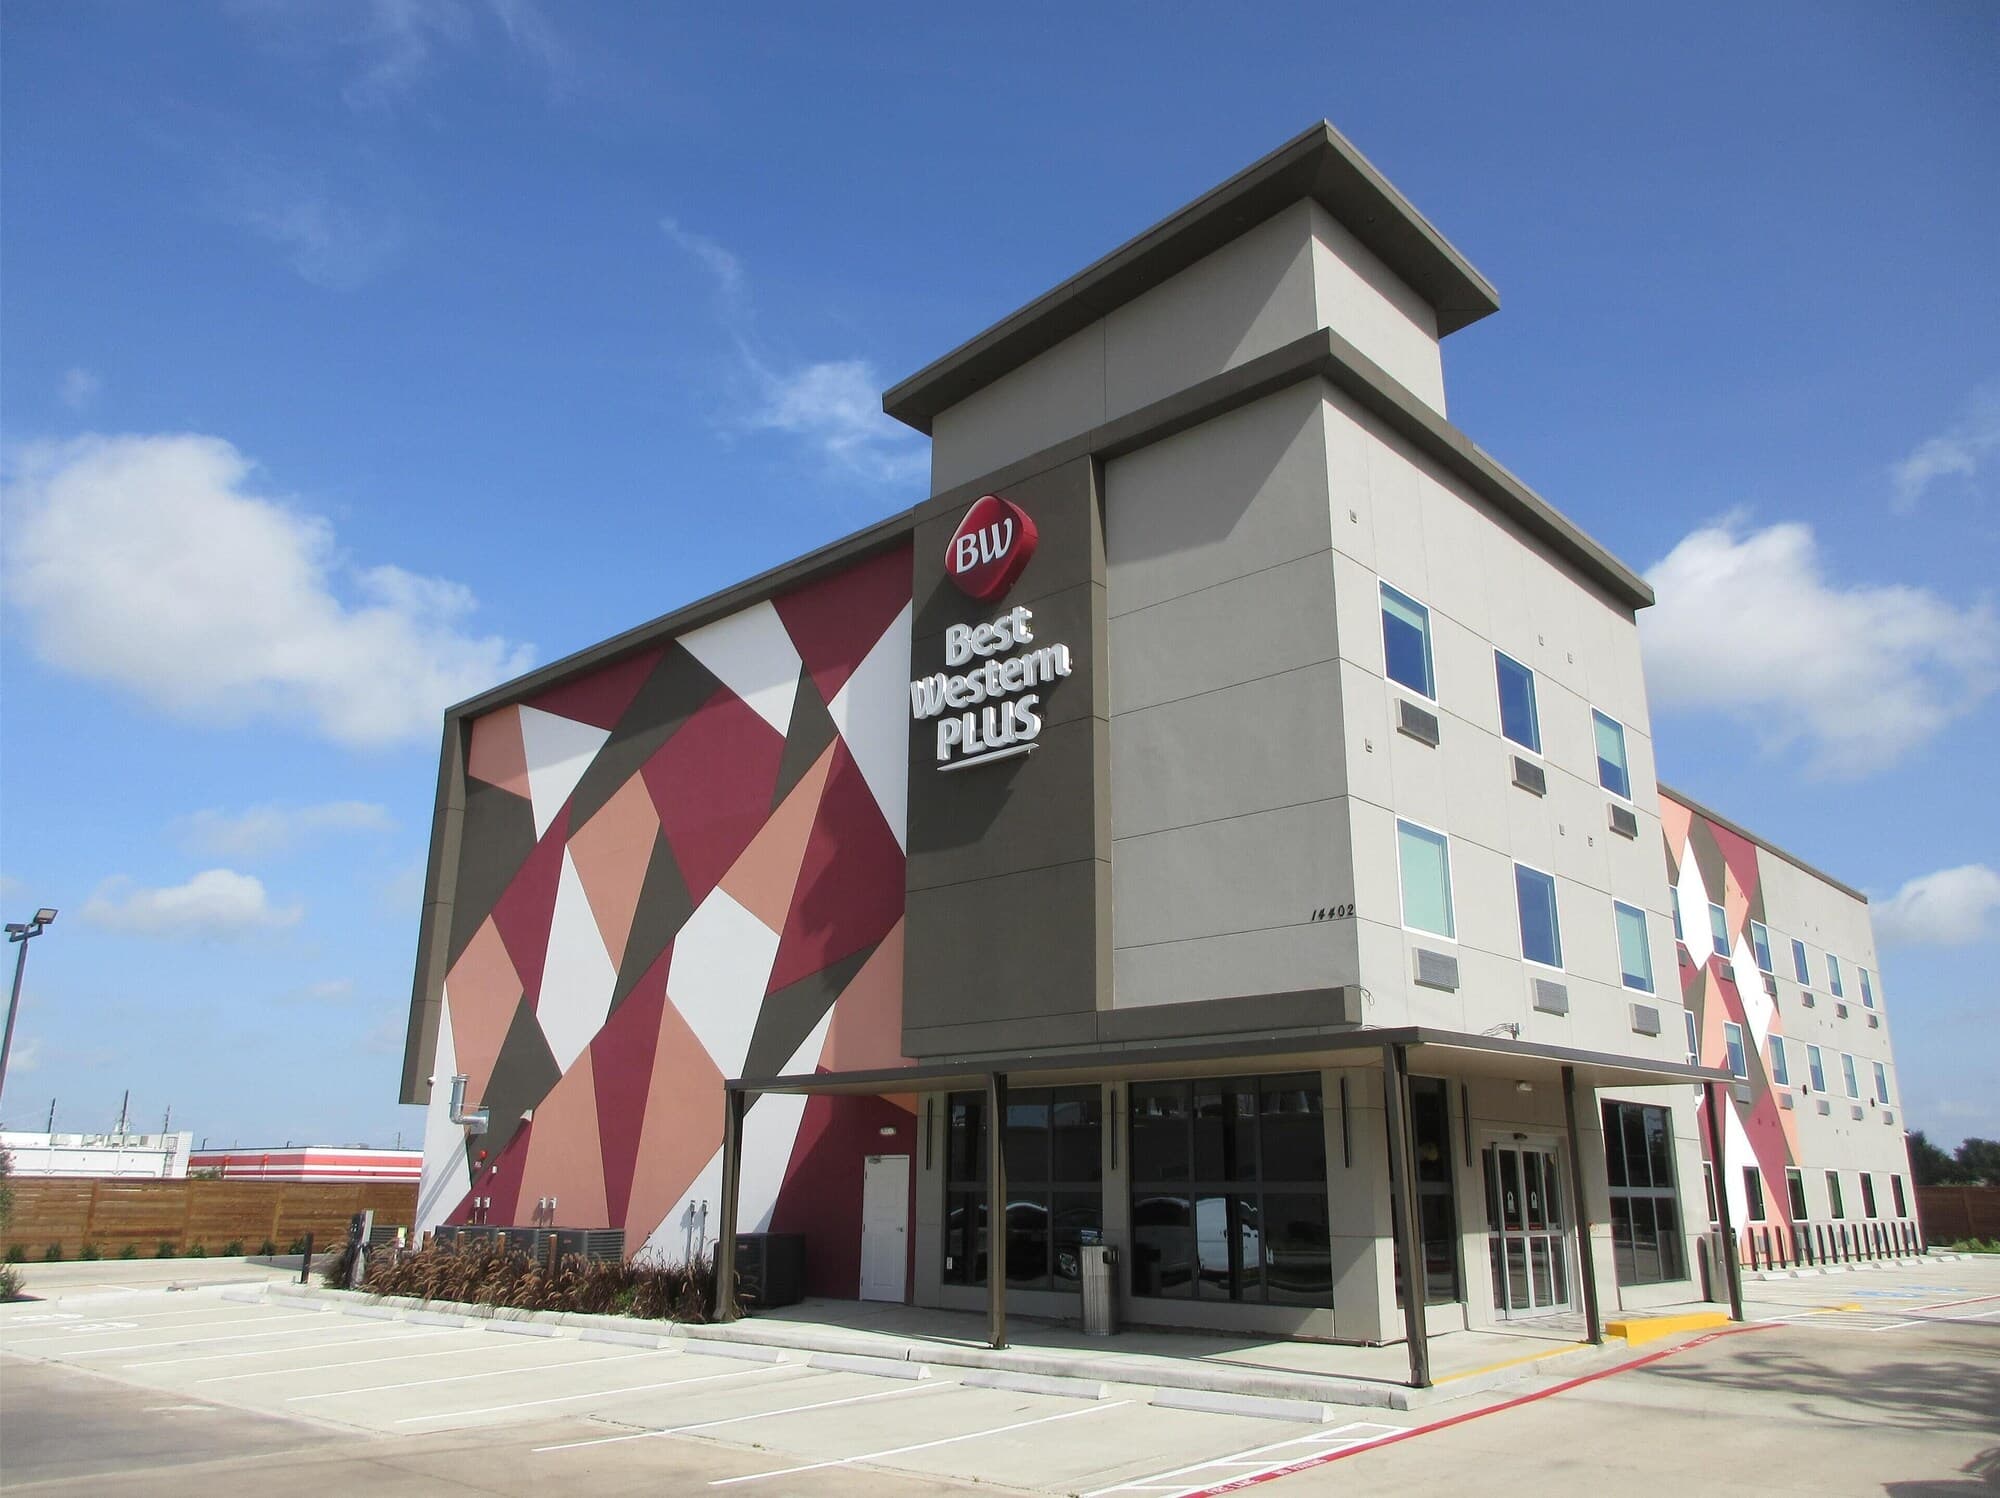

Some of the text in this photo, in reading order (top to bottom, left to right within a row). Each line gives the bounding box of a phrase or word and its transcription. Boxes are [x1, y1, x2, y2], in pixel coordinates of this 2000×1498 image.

[956, 517, 1013, 573] BW
[945, 605, 1034, 667] Best
[910, 643, 1072, 719] Western
[936, 694, 1041, 761] PLUS
[1311, 903, 1354, 921] 14402
